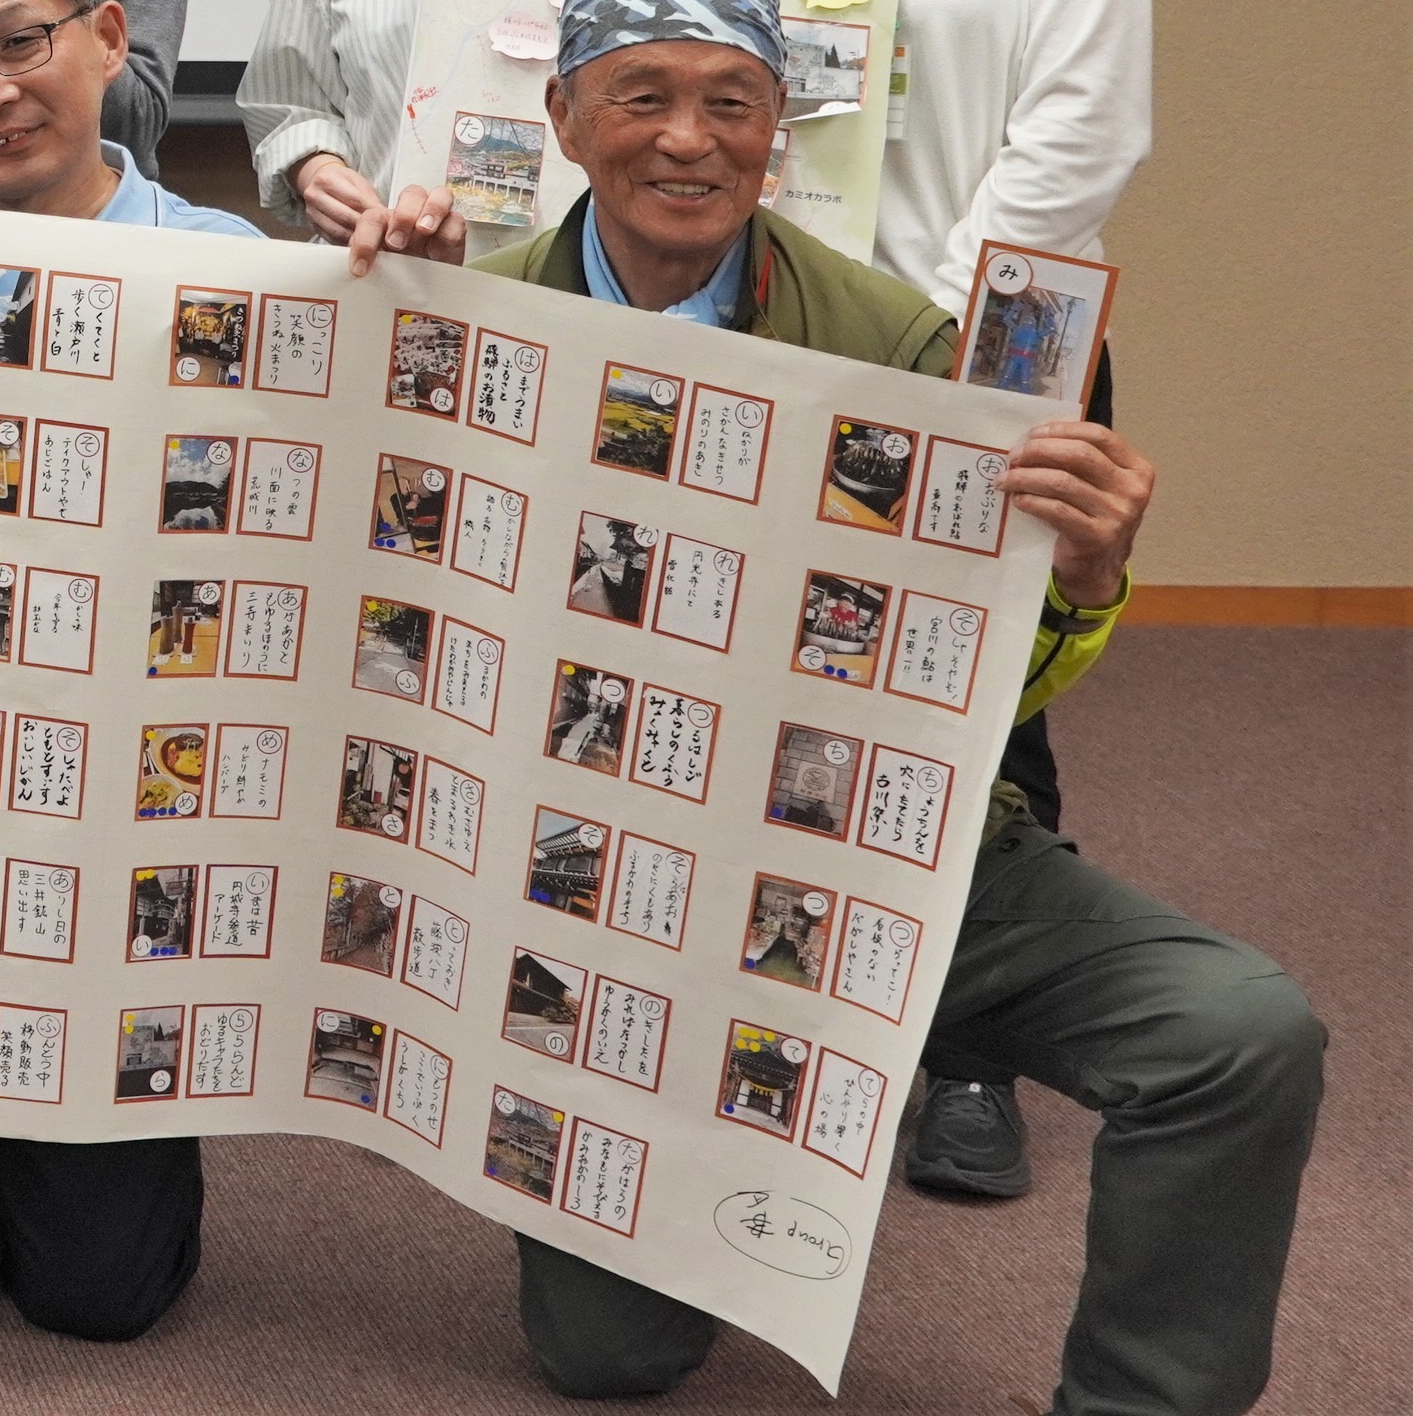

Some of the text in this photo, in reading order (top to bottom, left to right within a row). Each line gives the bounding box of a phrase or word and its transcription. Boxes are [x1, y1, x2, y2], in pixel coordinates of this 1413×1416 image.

[460, 118, 481, 138] た
[786, 189, 843, 204] カミオカラボ
[999, 264, 1018, 280] み
[181, 362, 196, 376] に
